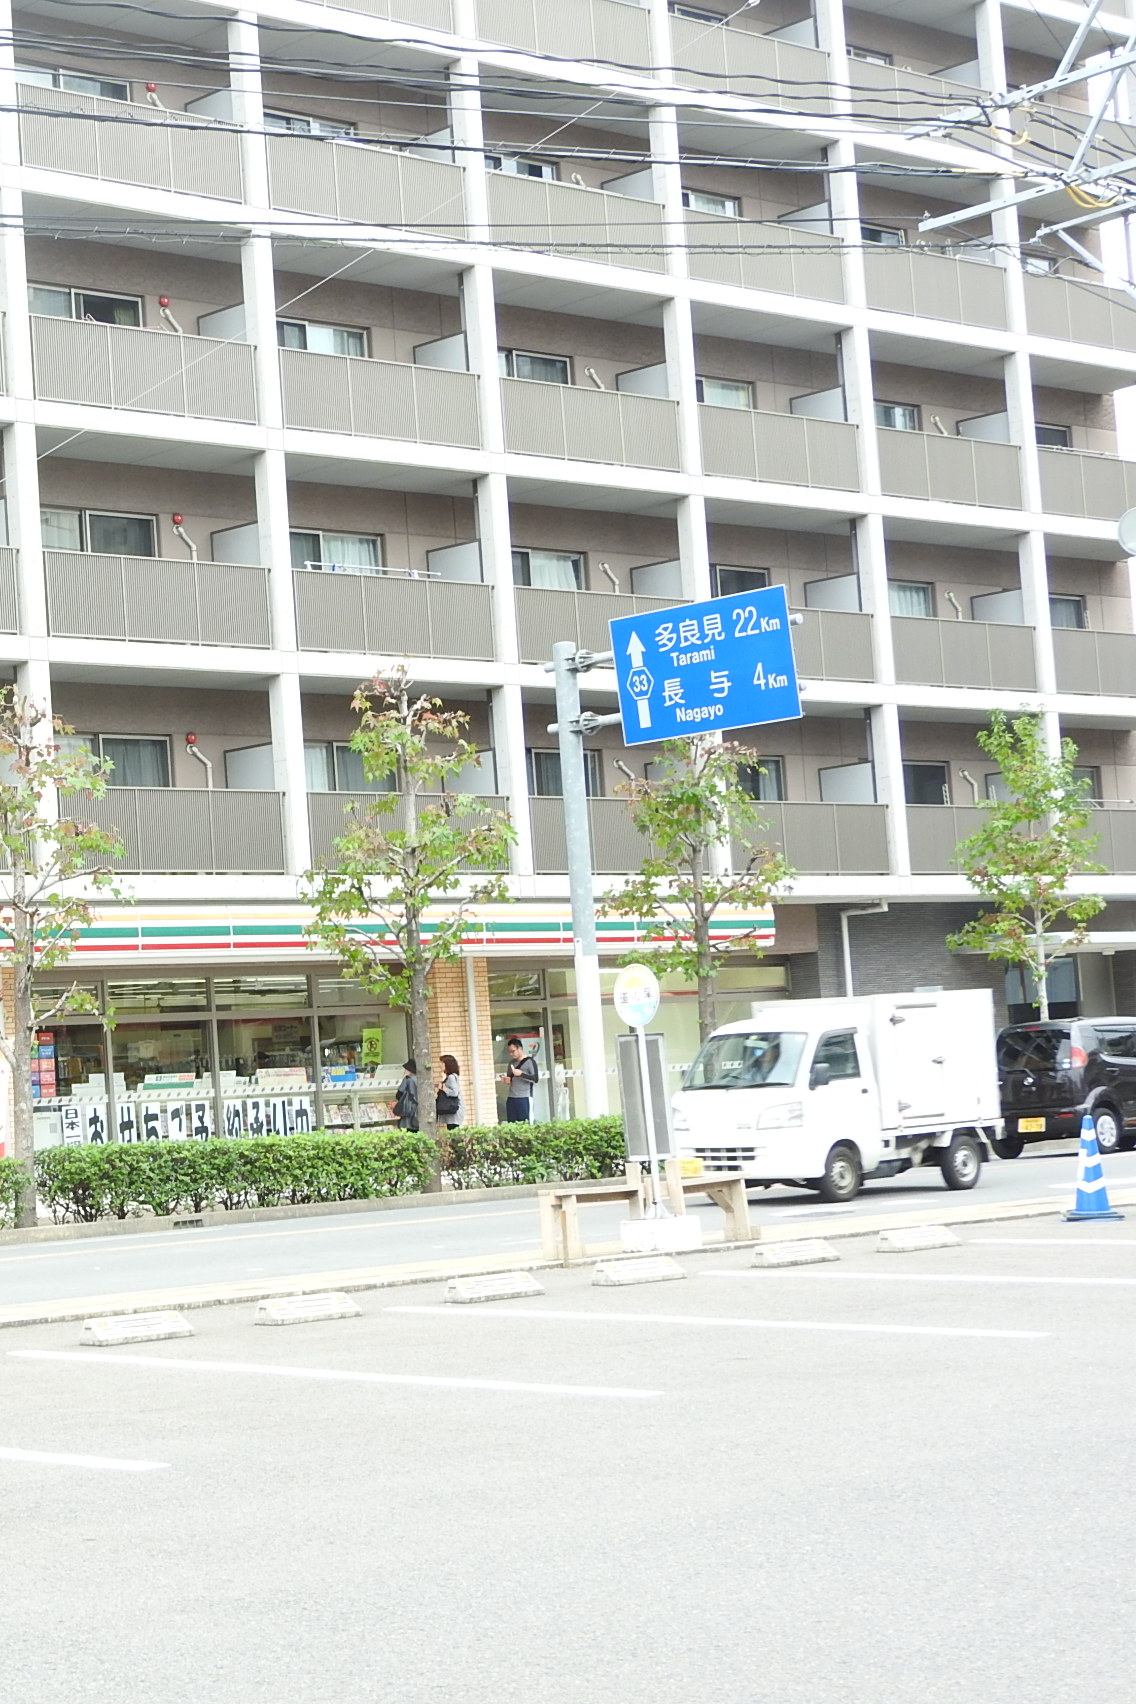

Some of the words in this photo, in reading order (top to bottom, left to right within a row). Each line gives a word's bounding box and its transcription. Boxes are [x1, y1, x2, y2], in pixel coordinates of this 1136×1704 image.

[655, 613, 725, 652] 多良見
[670, 645, 716, 668] Tarami
[632, 674, 648, 693] 33
[676, 704, 724, 723] Nagayo
